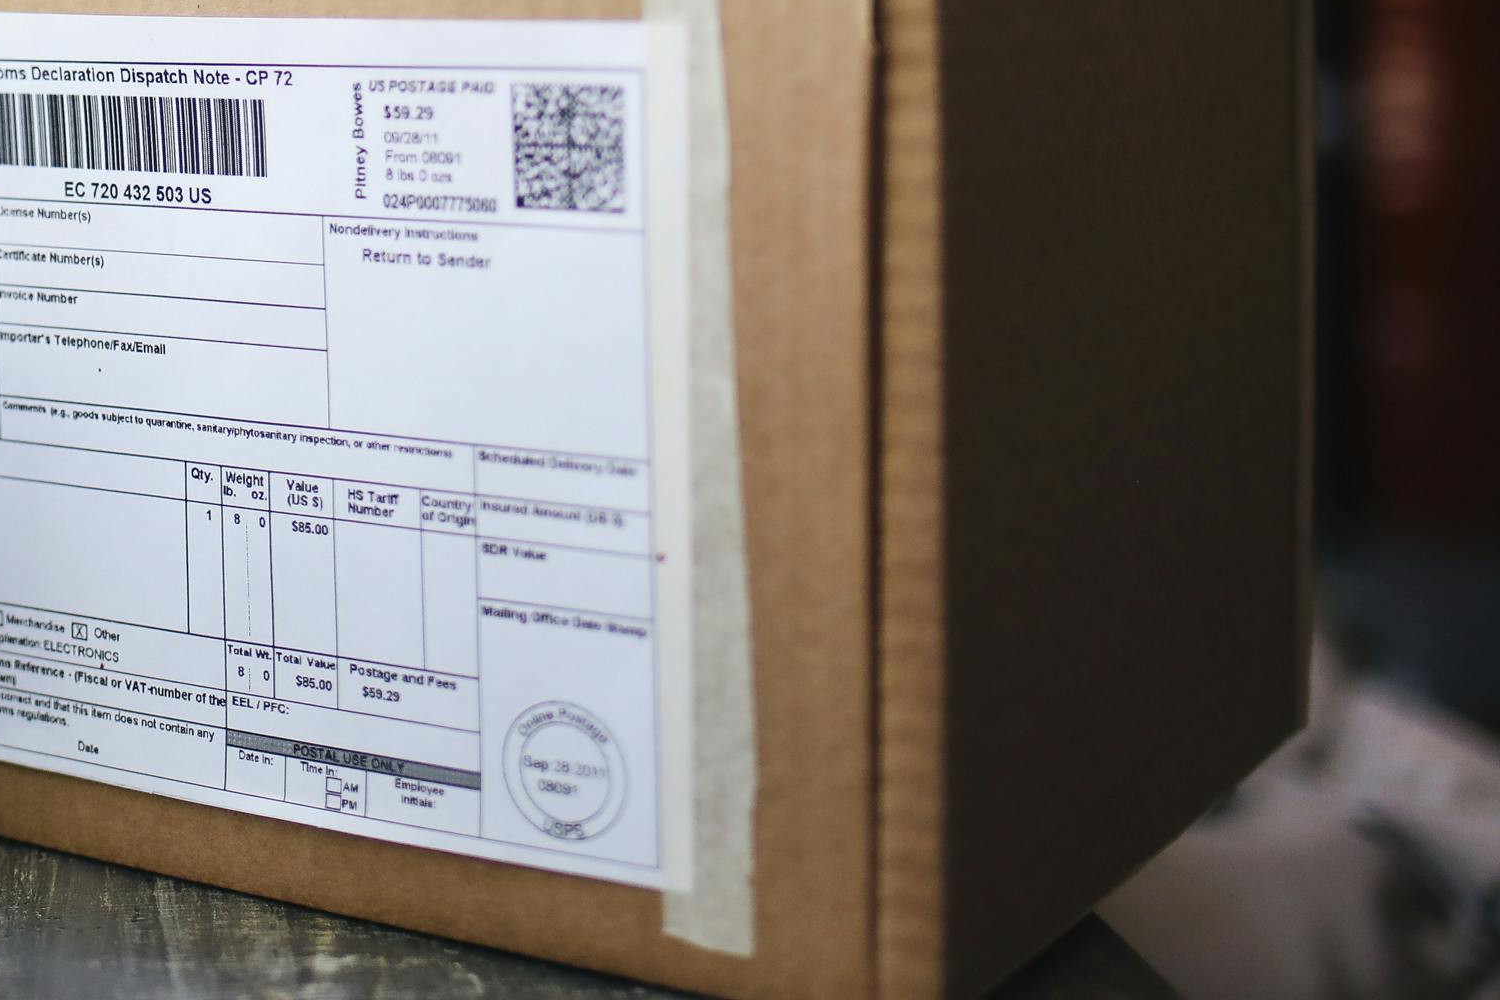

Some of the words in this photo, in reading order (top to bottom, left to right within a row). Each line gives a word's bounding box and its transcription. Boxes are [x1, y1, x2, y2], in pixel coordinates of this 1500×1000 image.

[31, 66, 115, 83] Declaration
[120, 67, 188, 87] Dispatch
[193, 69, 230, 85] Note
[245, 70, 269, 86] CP
[273, 71, 294, 86] 72
[368, 79, 385, 93] US
[388, 80, 457, 94] POSTAGE
[461, 80, 495, 95] PAID
[352, 81, 365, 139] Bowes
[383, 105, 434, 120] $59.29
[385, 150, 418, 164] From
[354, 145, 369, 200] Pitney
[385, 168, 394, 181] 8
[397, 168, 414, 182] lbs
[64, 181, 86, 198] EC
[90, 182, 119, 200] 720
[122, 183, 151, 201] 432
[156, 185, 185, 203] 503
[188, 187, 212, 204] US
[37, 208, 91, 224] Number(s)
[329, 222, 400, 239] Nondelivery
[50, 253, 104, 268] Number(s)
[362, 248, 411, 265] Return
[416, 251, 431, 265] to
[437, 252, 491, 270] Sender
[37, 292, 77, 305] Number
[0, 331, 51, 345] Importer's
[54, 335, 166, 355] Telephone/Fax/Email
[73, 410, 99, 421] goods
[102, 412, 133, 424] subject
[134, 414, 144, 424] to
[146, 416, 195, 431] quarantine,
[197, 421, 297, 443] sanitary/phytosanitary
[300, 433, 350, 448] inspection,
[353, 439, 363, 448] or
[366, 439, 390, 452] other
[191, 466, 214, 482] Qty.
[225, 471, 264, 488] Weight
[223, 485, 237, 498] lb.
[251, 490, 267, 501] oz.
[286, 479, 319, 494] Value
[287, 493, 309, 507] (US
[347, 488, 364, 502] HS
[368, 490, 400, 505] Tariff
[421, 495, 472, 512] Country
[206, 510, 212, 521] 1
[347, 502, 394, 518] Number
[422, 510, 434, 522] of
[437, 511, 476, 527] Origin
[233, 512, 240, 525] 8
[258, 516, 266, 528] 0
[291, 520, 329, 536] $85.00
[482, 606, 527, 623] Mailing
[6, 614, 65, 634] Merchandise
[94, 628, 120, 642] Other
[43, 640, 120, 663] ELECTRONICS
[227, 644, 252, 658] Total
[255, 649, 272, 661] Wt.
[276, 652, 302, 665] Total
[307, 656, 336, 670] Value
[237, 666, 245, 677] 8
[263, 670, 270, 681] 0
[349, 664, 398, 683] Postage
[402, 671, 424, 686] and
[427, 675, 457, 691] Fees
[14, 660, 65, 679] Reference
[74, 670, 108, 688] (Fiscal
[111, 678, 122, 688] or
[125, 678, 192, 702] VAT-number
[195, 691, 208, 705] of
[210, 694, 227, 708] the
[295, 675, 333, 692] $85.00
[362, 685, 400, 703] $59.29
[231, 695, 253, 710] EEL
[263, 701, 290, 715] PFC:
[35, 695, 52, 708] and
[53, 698, 70, 712] that
[73, 703, 88, 716] this
[91, 706, 112, 721] item
[114, 711, 139, 727] does
[141, 717, 157, 731] not
[159, 721, 194, 737] contain
[197, 729, 215, 743] any
[77, 740, 99, 754] Date
[238, 750, 260, 763] Date
[293, 743, 341, 764] POSTAL
[343, 752, 367, 768] USE
[371, 757, 406, 774] ONLY
[523, 755, 549, 772] Sep
[554, 760, 570, 773] 28
[300, 761, 323, 775] Time
[343, 782, 359, 794] AM
[394, 778, 445, 796] Employee
[341, 799, 358, 811] PM
